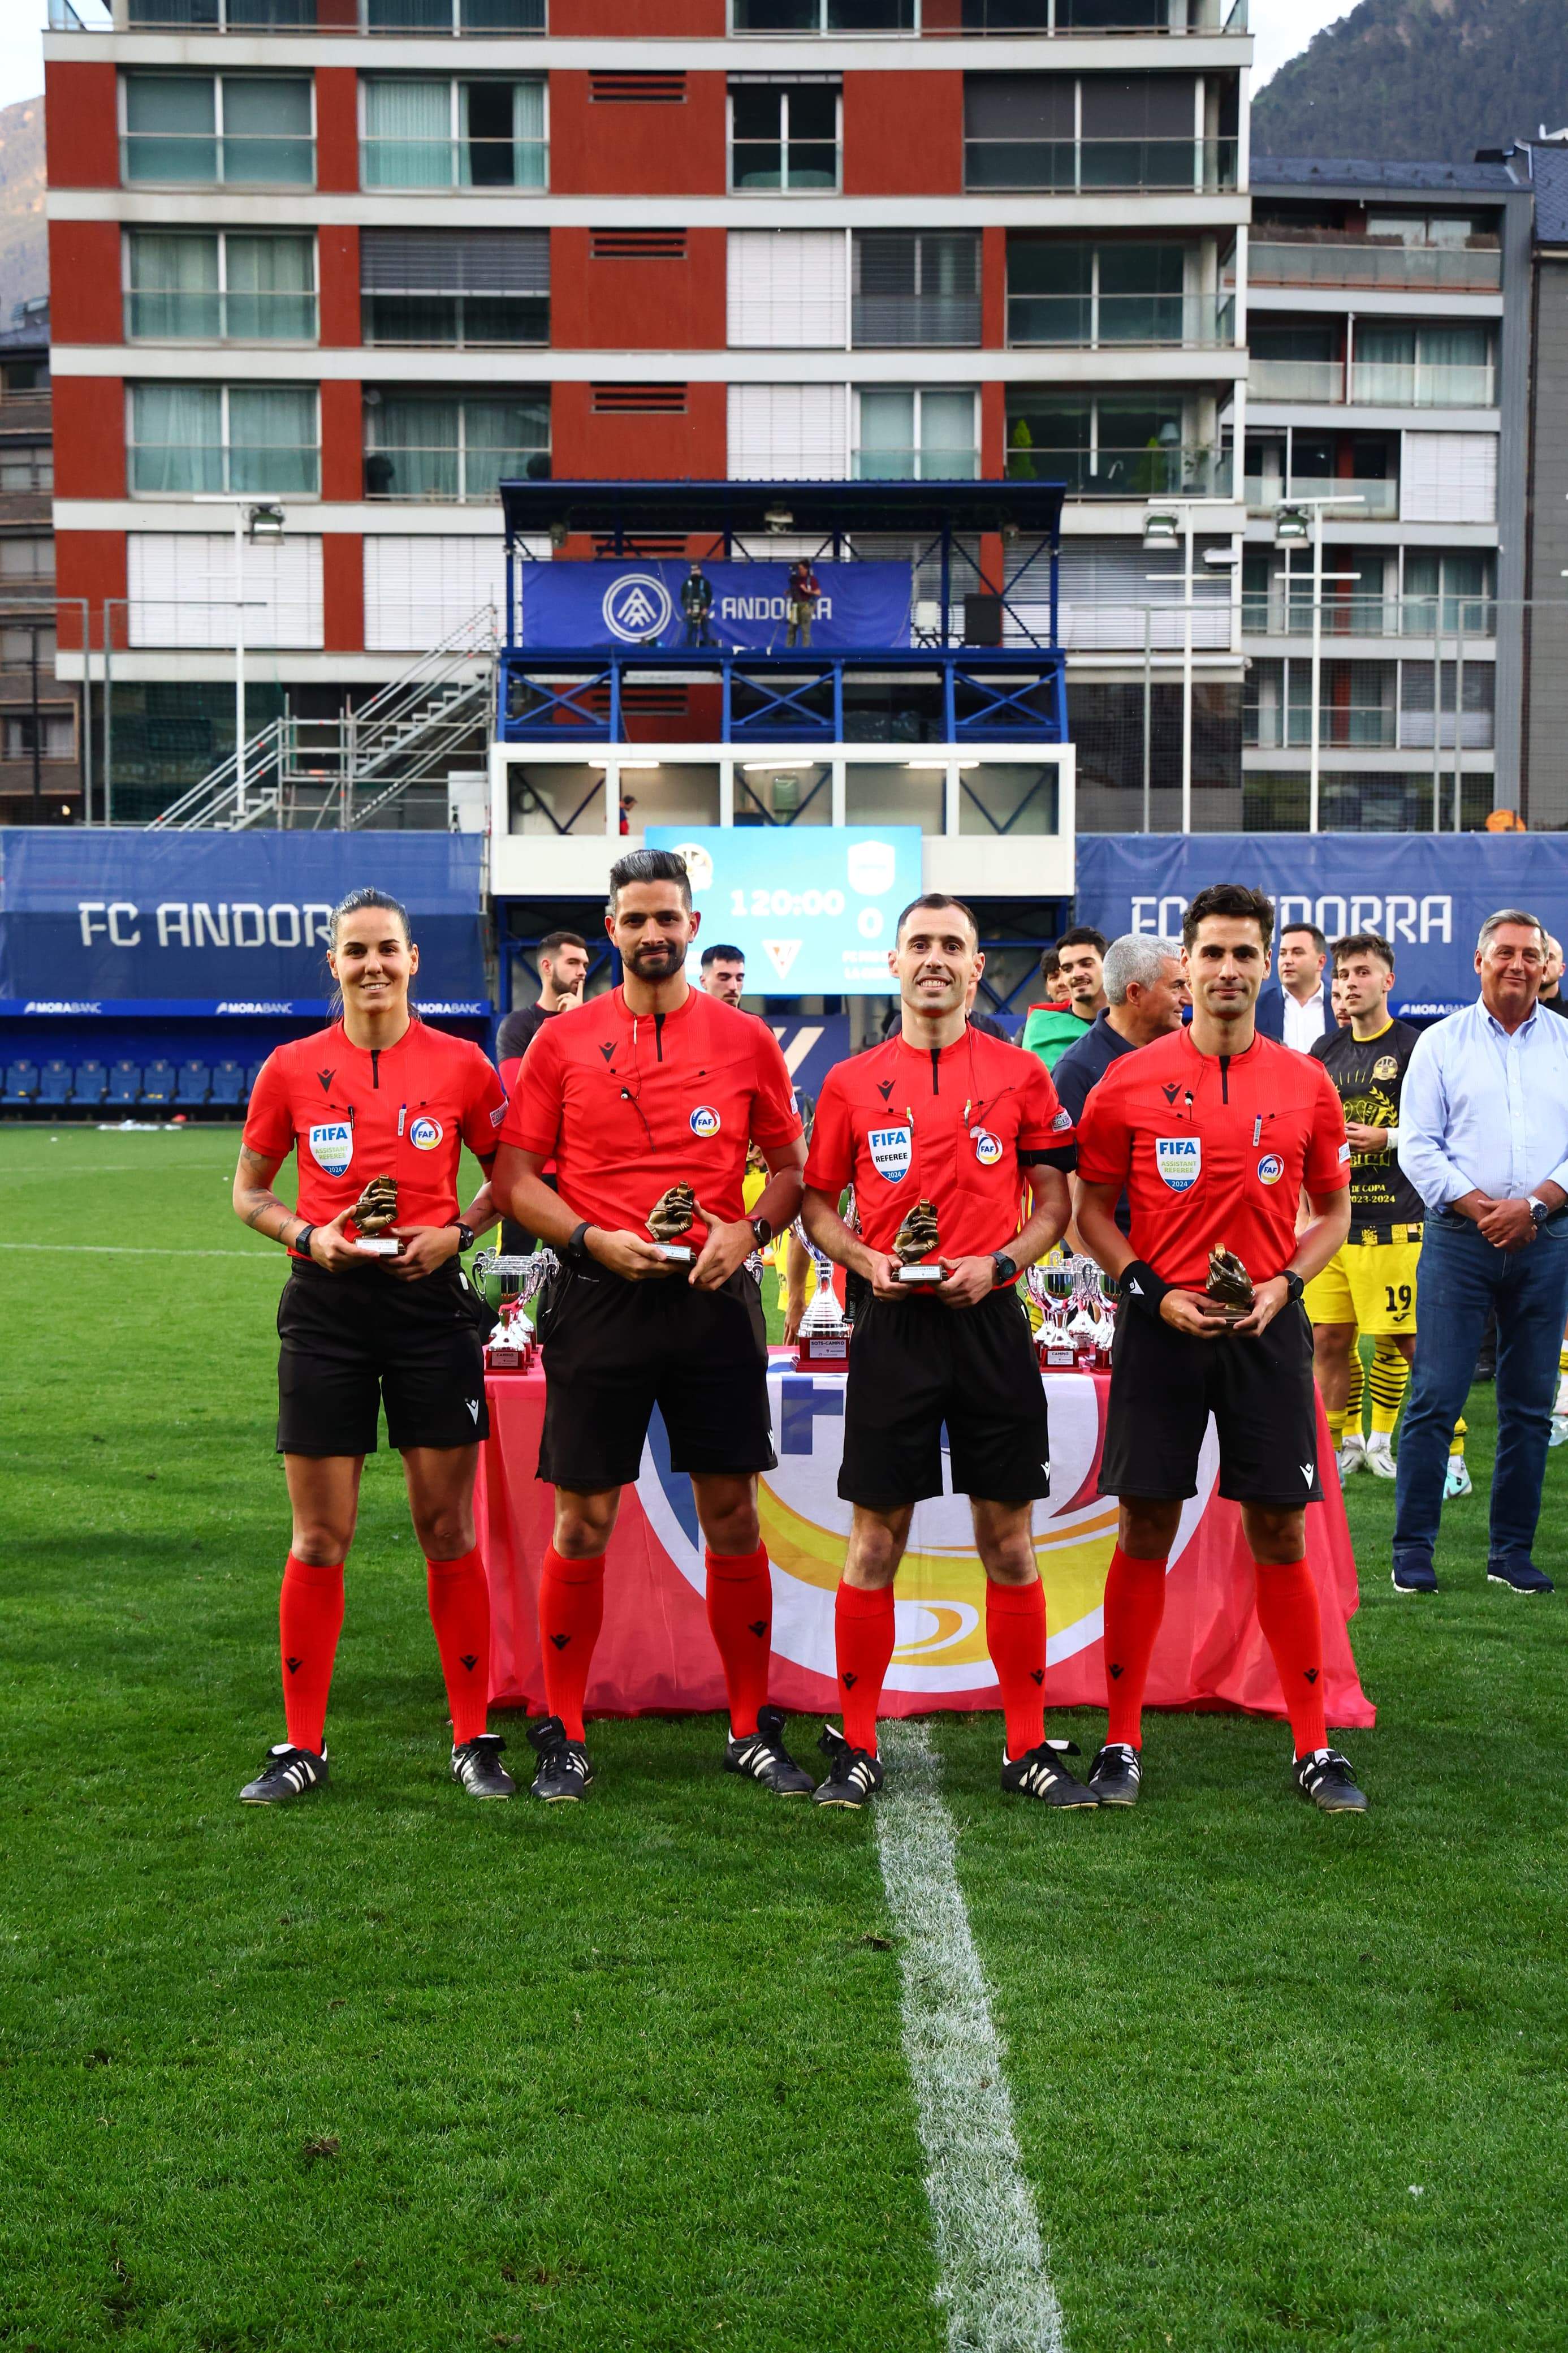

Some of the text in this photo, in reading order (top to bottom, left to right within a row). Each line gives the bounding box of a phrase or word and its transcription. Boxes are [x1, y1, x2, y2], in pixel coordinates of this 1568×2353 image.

[722, 597, 832, 620] ANDOA
[730, 889, 845, 916] 120:00
[78, 902, 334, 947] FC ANDOR
[857, 908, 884, 938] 0
[1131, 895, 1452, 943] FC DORRA
[36, 1002, 102, 1013] MORABANC
[227, 1002, 293, 1014] MORABANC
[418, 1002, 481, 1014] MORABANC
[313, 1127, 348, 1142] FIFA
[872, 1131, 907, 1147] FIFA
[1160, 1141, 1196, 1154] FIFA
[875, 1152, 908, 1162] REFEREE
[1362, 1184, 1386, 1192] COPA
[1350, 1195, 1396, 1203] 023-2024
[1385, 1285, 1411, 1312] 19
